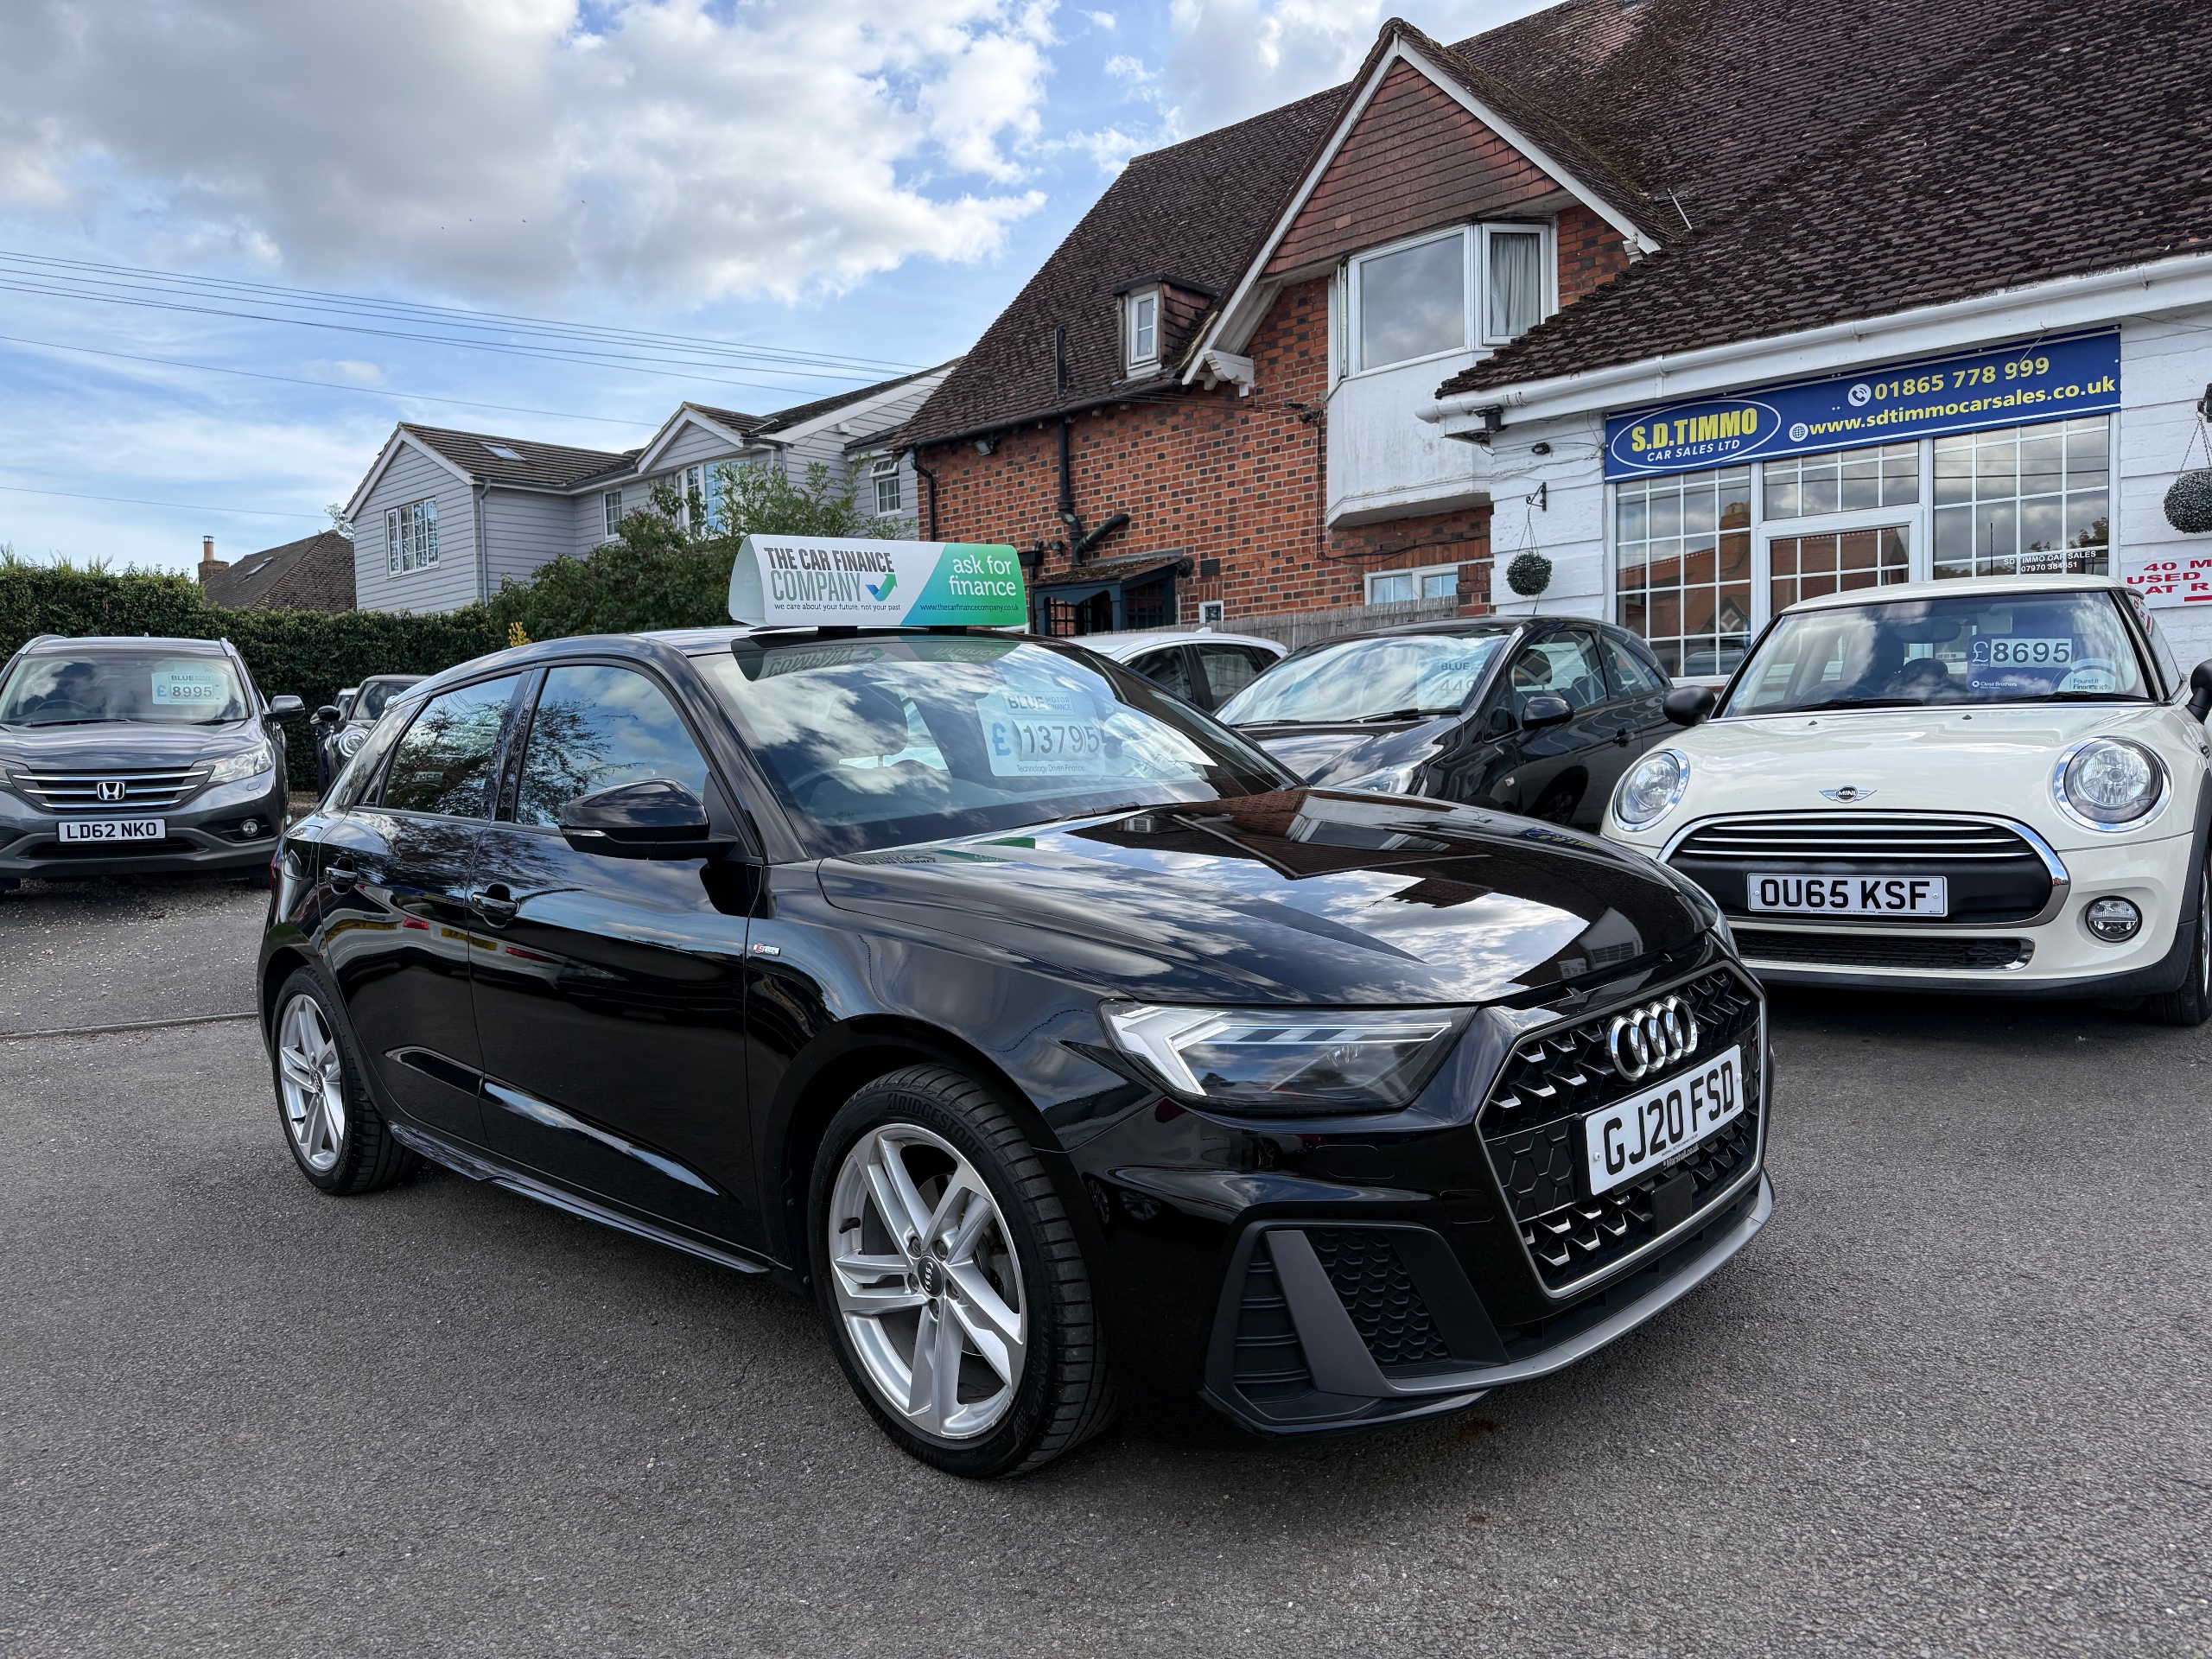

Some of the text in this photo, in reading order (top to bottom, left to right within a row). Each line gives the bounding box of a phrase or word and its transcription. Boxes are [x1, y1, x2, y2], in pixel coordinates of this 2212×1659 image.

[1875, 357, 2050, 401] 01865 778 999
[1809, 377, 2116, 436] www.sdtimmocarsales.co.uk
[1631, 407, 1758, 452] S.D.TIMMO
[1647, 439, 1741, 462] CAR SALES LTD
[764, 547, 895, 572] THE CAR FINANCE
[952, 555, 1012, 575] ask for
[2019, 555, 2045, 563] IMMO
[2068, 550, 2096, 560] SALES
[2144, 562, 2177, 571] 40
[770, 570, 861, 601] COMPANY
[948, 575, 1017, 596] finance
[2126, 572, 2201, 584] USED
[2145, 584, 2178, 594] AT
[1440, 662, 1470, 671] BLUE
[1007, 696, 1048, 710] BLUE
[1023, 725, 1100, 754] 13795
[1017, 765, 1047, 773] Technology
[67, 822, 157, 839] LD62 NKO
[1760, 879, 1930, 910] OU65 KSF
[887, 1092, 985, 1161] BRIDGESTONE
[1603, 1059, 1735, 1175] GJ20 FSD
